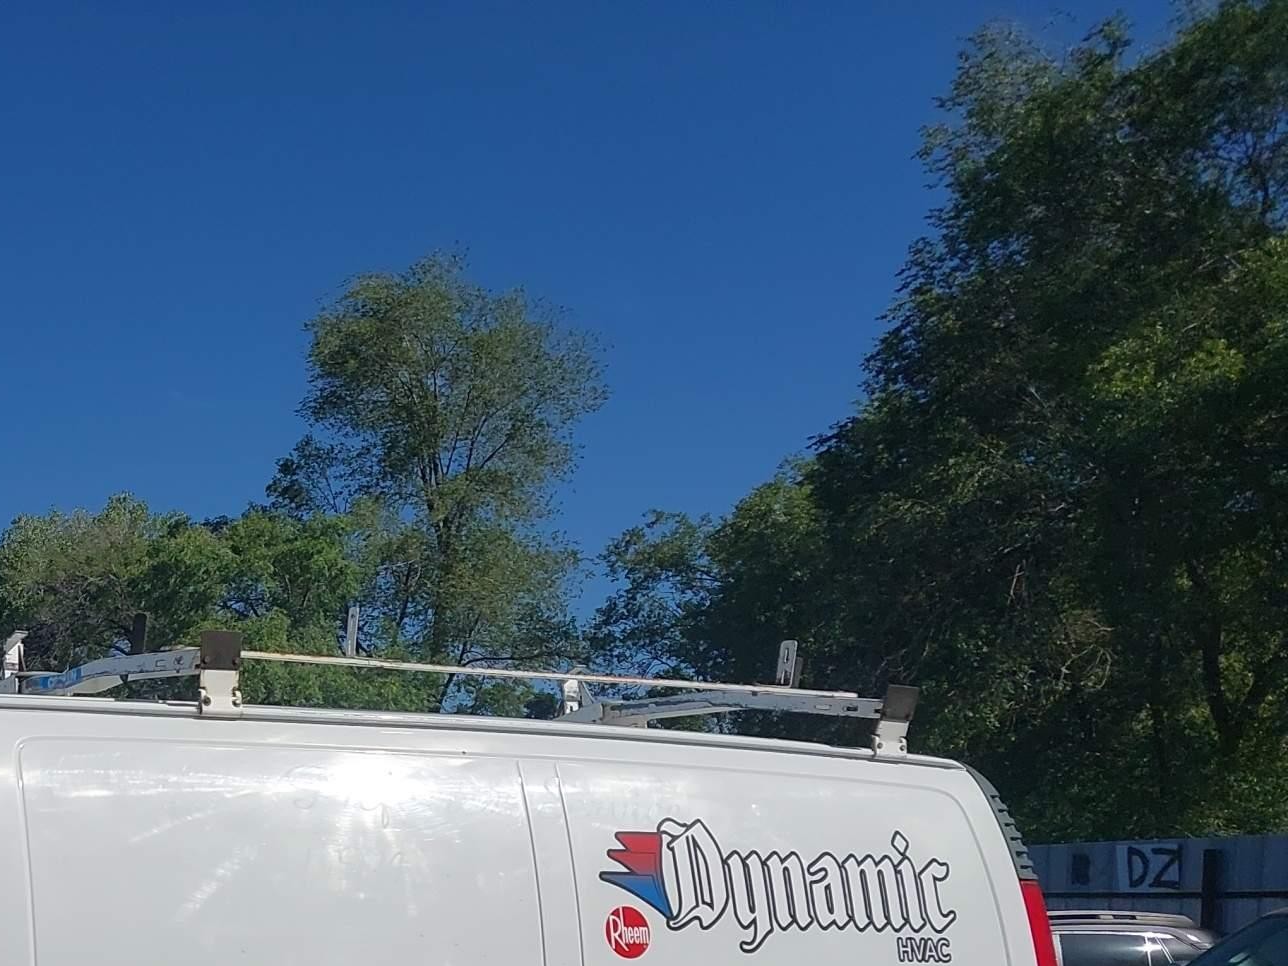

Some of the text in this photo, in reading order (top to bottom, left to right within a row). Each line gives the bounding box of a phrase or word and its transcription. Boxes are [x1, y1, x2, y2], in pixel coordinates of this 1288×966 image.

[657, 818, 956, 953] Dynamic
[608, 907, 649, 951] Rheem
[896, 937, 952, 963] HVAC
